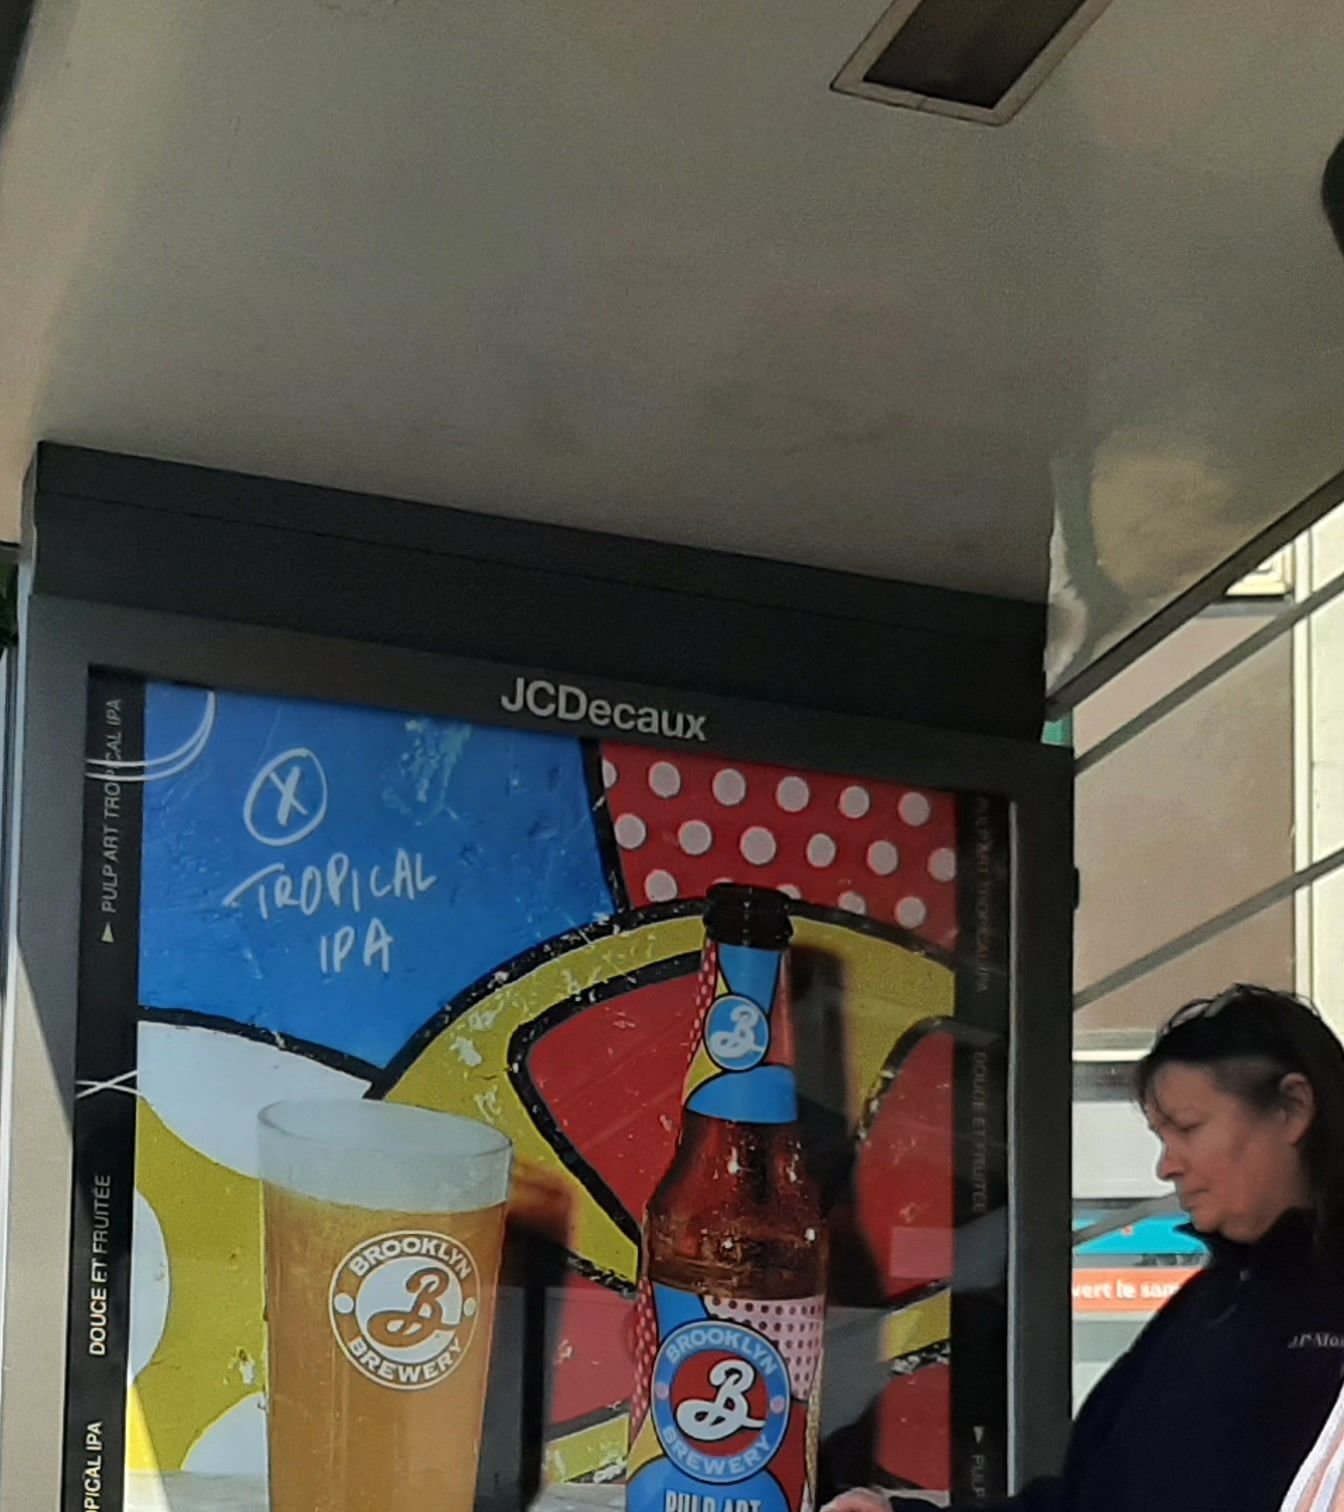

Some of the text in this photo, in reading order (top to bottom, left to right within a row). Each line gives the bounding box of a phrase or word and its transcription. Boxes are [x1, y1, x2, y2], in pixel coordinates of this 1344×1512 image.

[106, 699, 123, 726] IPA
[501, 677, 707, 741] JCDecaux
[103, 825, 120, 863] ART
[102, 864, 119, 913] PULP
[223, 848, 437, 920] TROPICAL
[320, 917, 393, 974] IPA
[89, 1174, 111, 1356] DOUCE ET FRUITÉE
[348, 1237, 472, 1279] BROOKLYN
[348, 1336, 462, 1383] BREWERY
[665, 1328, 778, 1376] BROOKLYN
[85, 1421, 104, 1451] IPA
[662, 1425, 770, 1475] BREWERY
